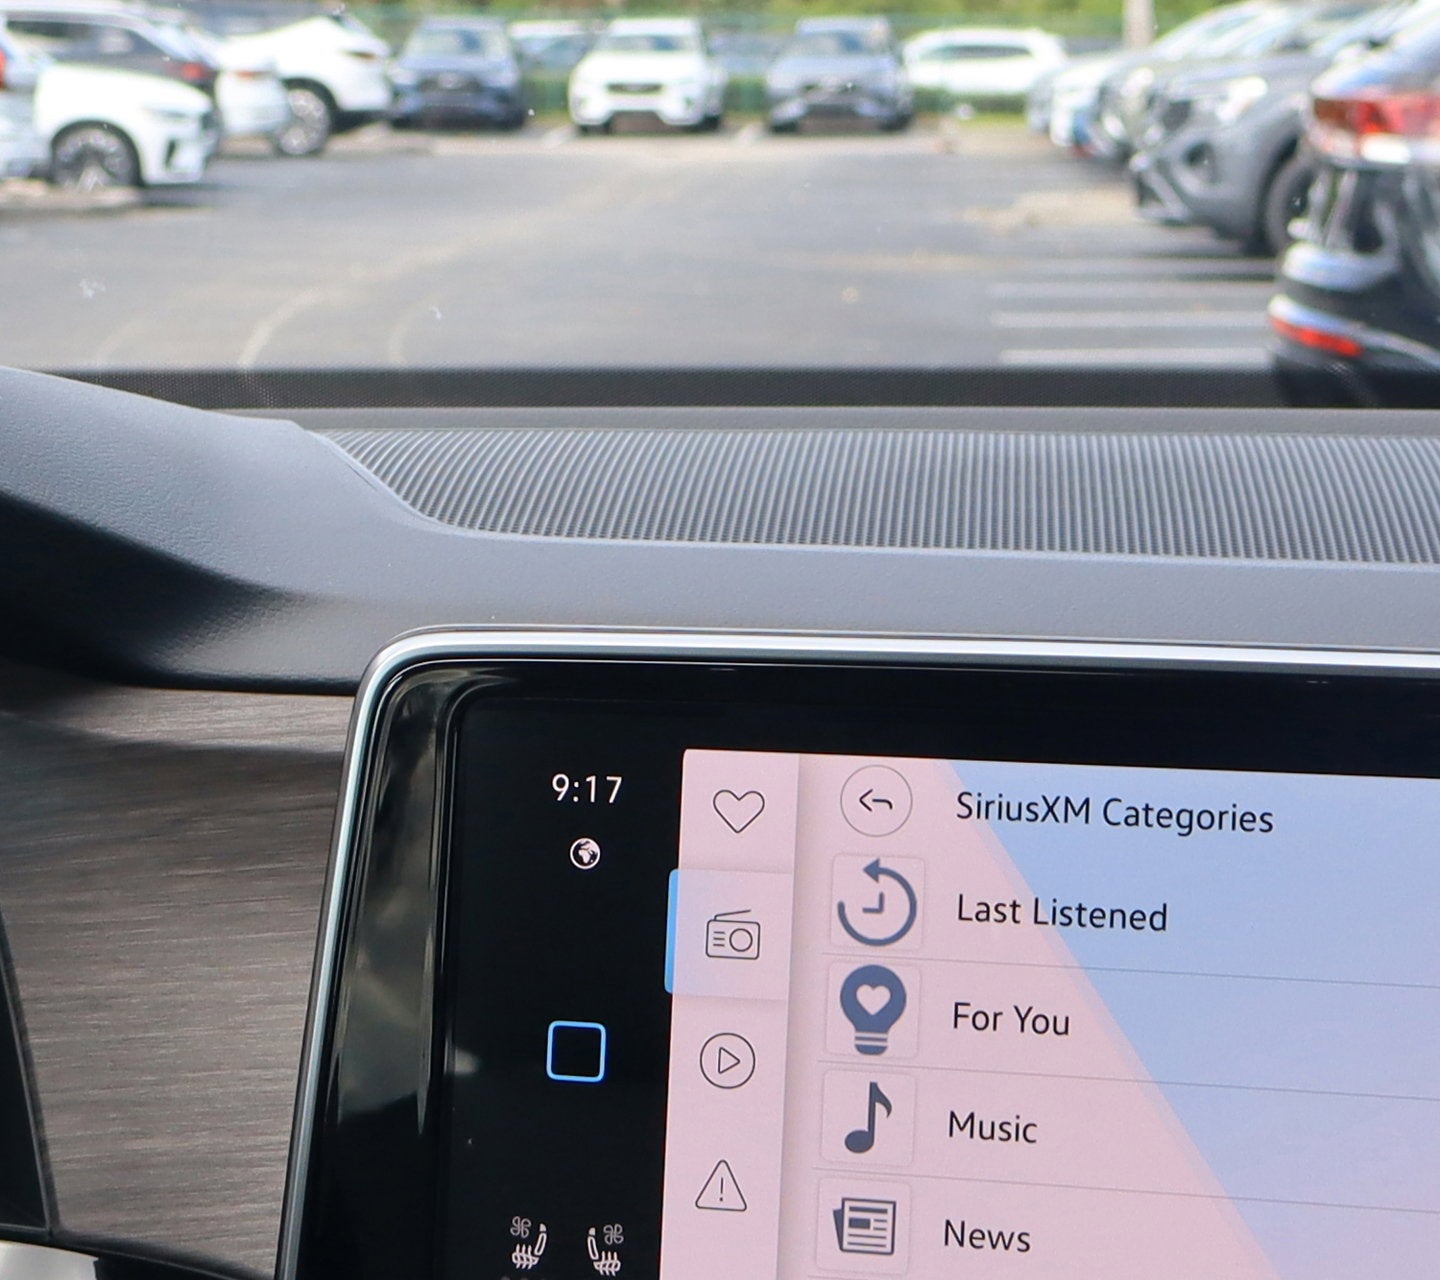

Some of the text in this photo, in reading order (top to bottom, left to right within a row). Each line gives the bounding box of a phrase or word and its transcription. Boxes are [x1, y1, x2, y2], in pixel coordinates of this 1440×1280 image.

[552, 773, 622, 804] 9:17
[956, 791, 1274, 837] SiriusXM Categories
[958, 893, 1167, 932] Last Listened
[953, 1001, 1070, 1036] For You
[948, 1110, 1038, 1144] Music
[944, 1219, 1031, 1253] News
